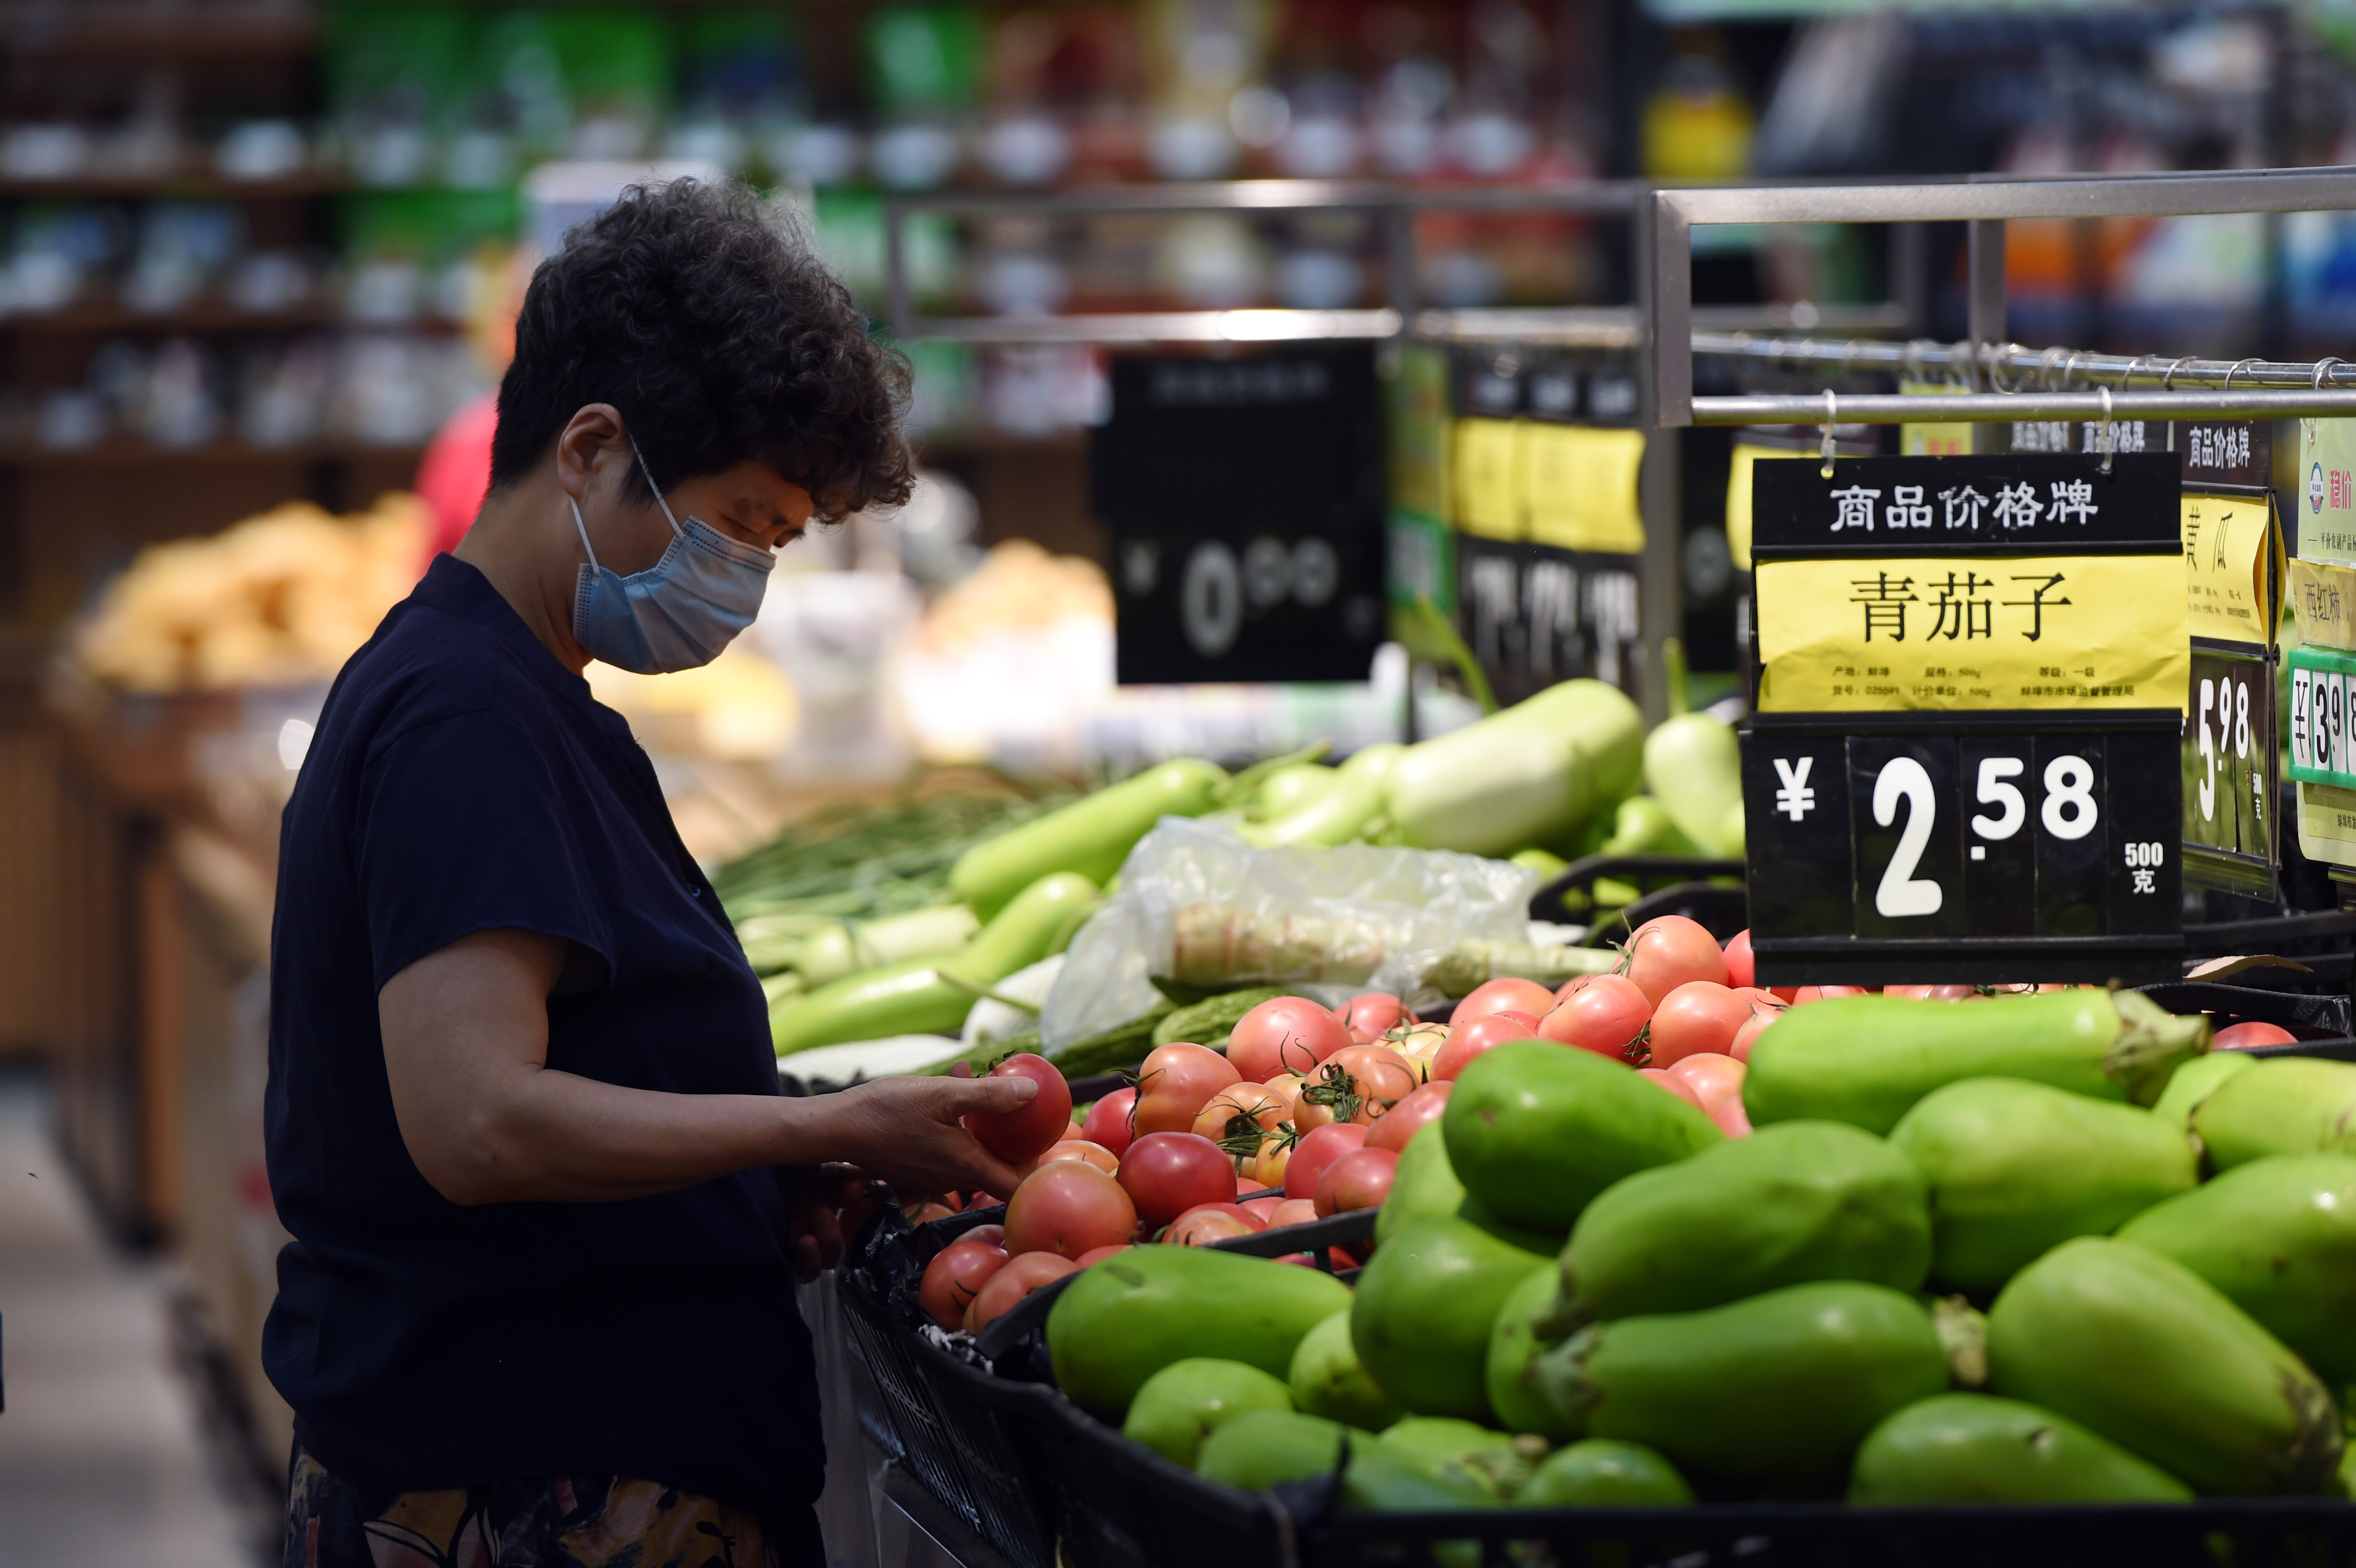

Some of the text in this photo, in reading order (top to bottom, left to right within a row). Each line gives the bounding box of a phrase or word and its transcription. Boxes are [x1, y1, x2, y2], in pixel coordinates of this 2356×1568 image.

[2189, 425, 2250, 469] 商品价格牌
[1830, 479, 2099, 533] 商品价格牌
[1850, 571, 2072, 642] 青茄子
[2304, 582, 2340, 625] 西红柿
[2296, 680, 2308, 759] ¥
[2200, 676, 2249, 822] 5.98
[2253, 773, 2262, 795] 500
[2255, 797, 2262, 819] 克
[1773, 755, 2098, 917] ¥ 2.58
[2125, 842, 2163, 868] 500
[2131, 868, 2156, 895] 克
